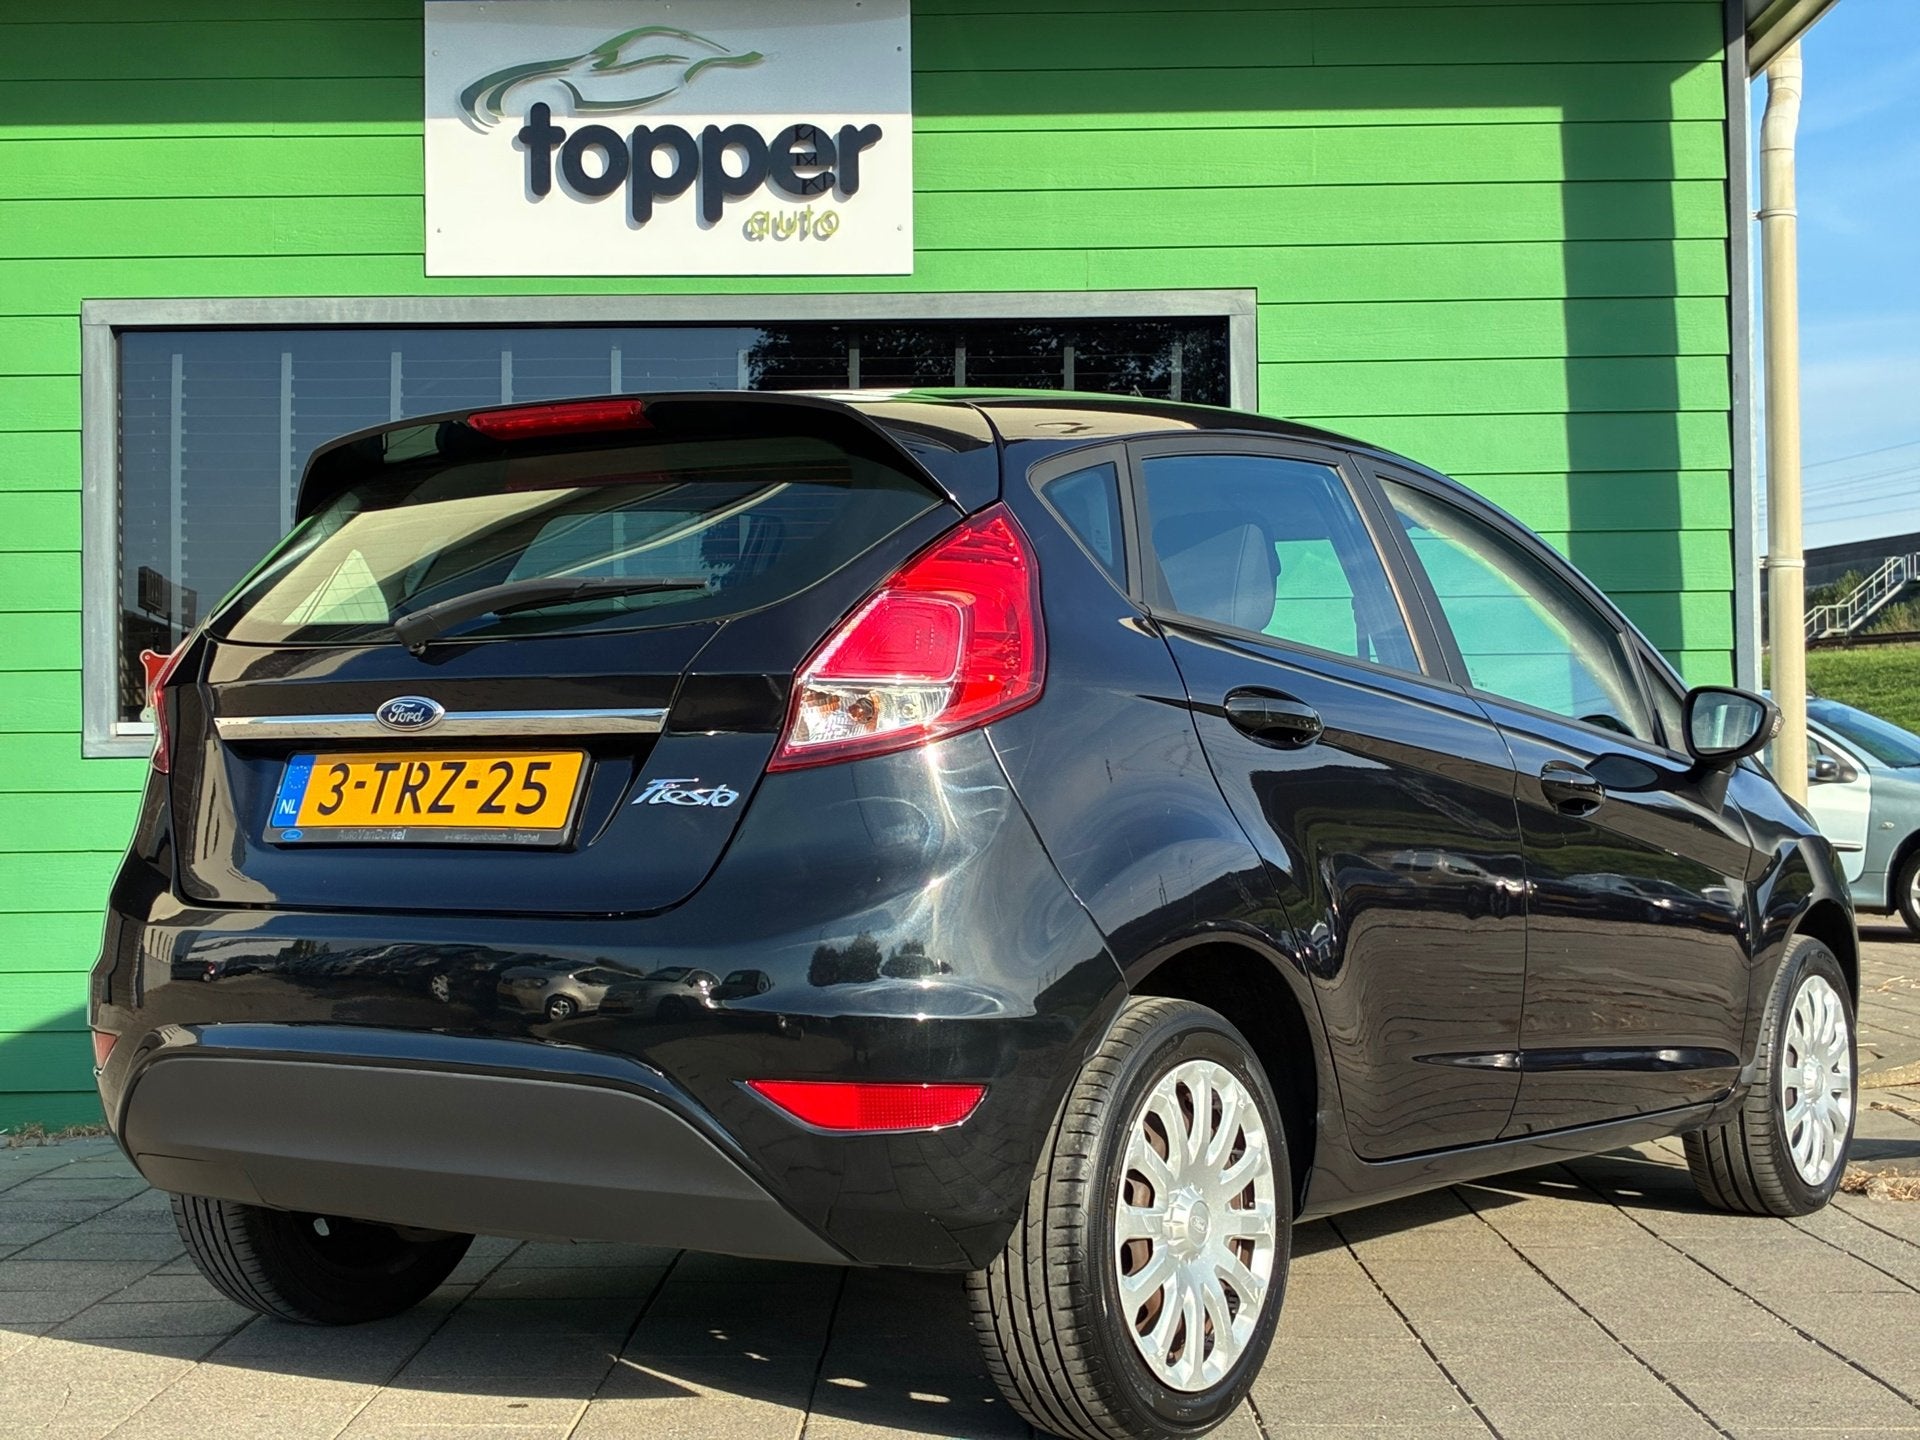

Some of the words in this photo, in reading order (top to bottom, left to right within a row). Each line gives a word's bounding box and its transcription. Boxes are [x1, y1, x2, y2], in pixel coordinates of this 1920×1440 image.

[518, 102, 883, 223] topper
[749, 204, 839, 236] auto
[388, 703, 425, 723] Ford
[316, 761, 552, 815] 3-TRZ-25
[631, 778, 740, 807] Fiesta
[279, 799, 297, 814] NL
